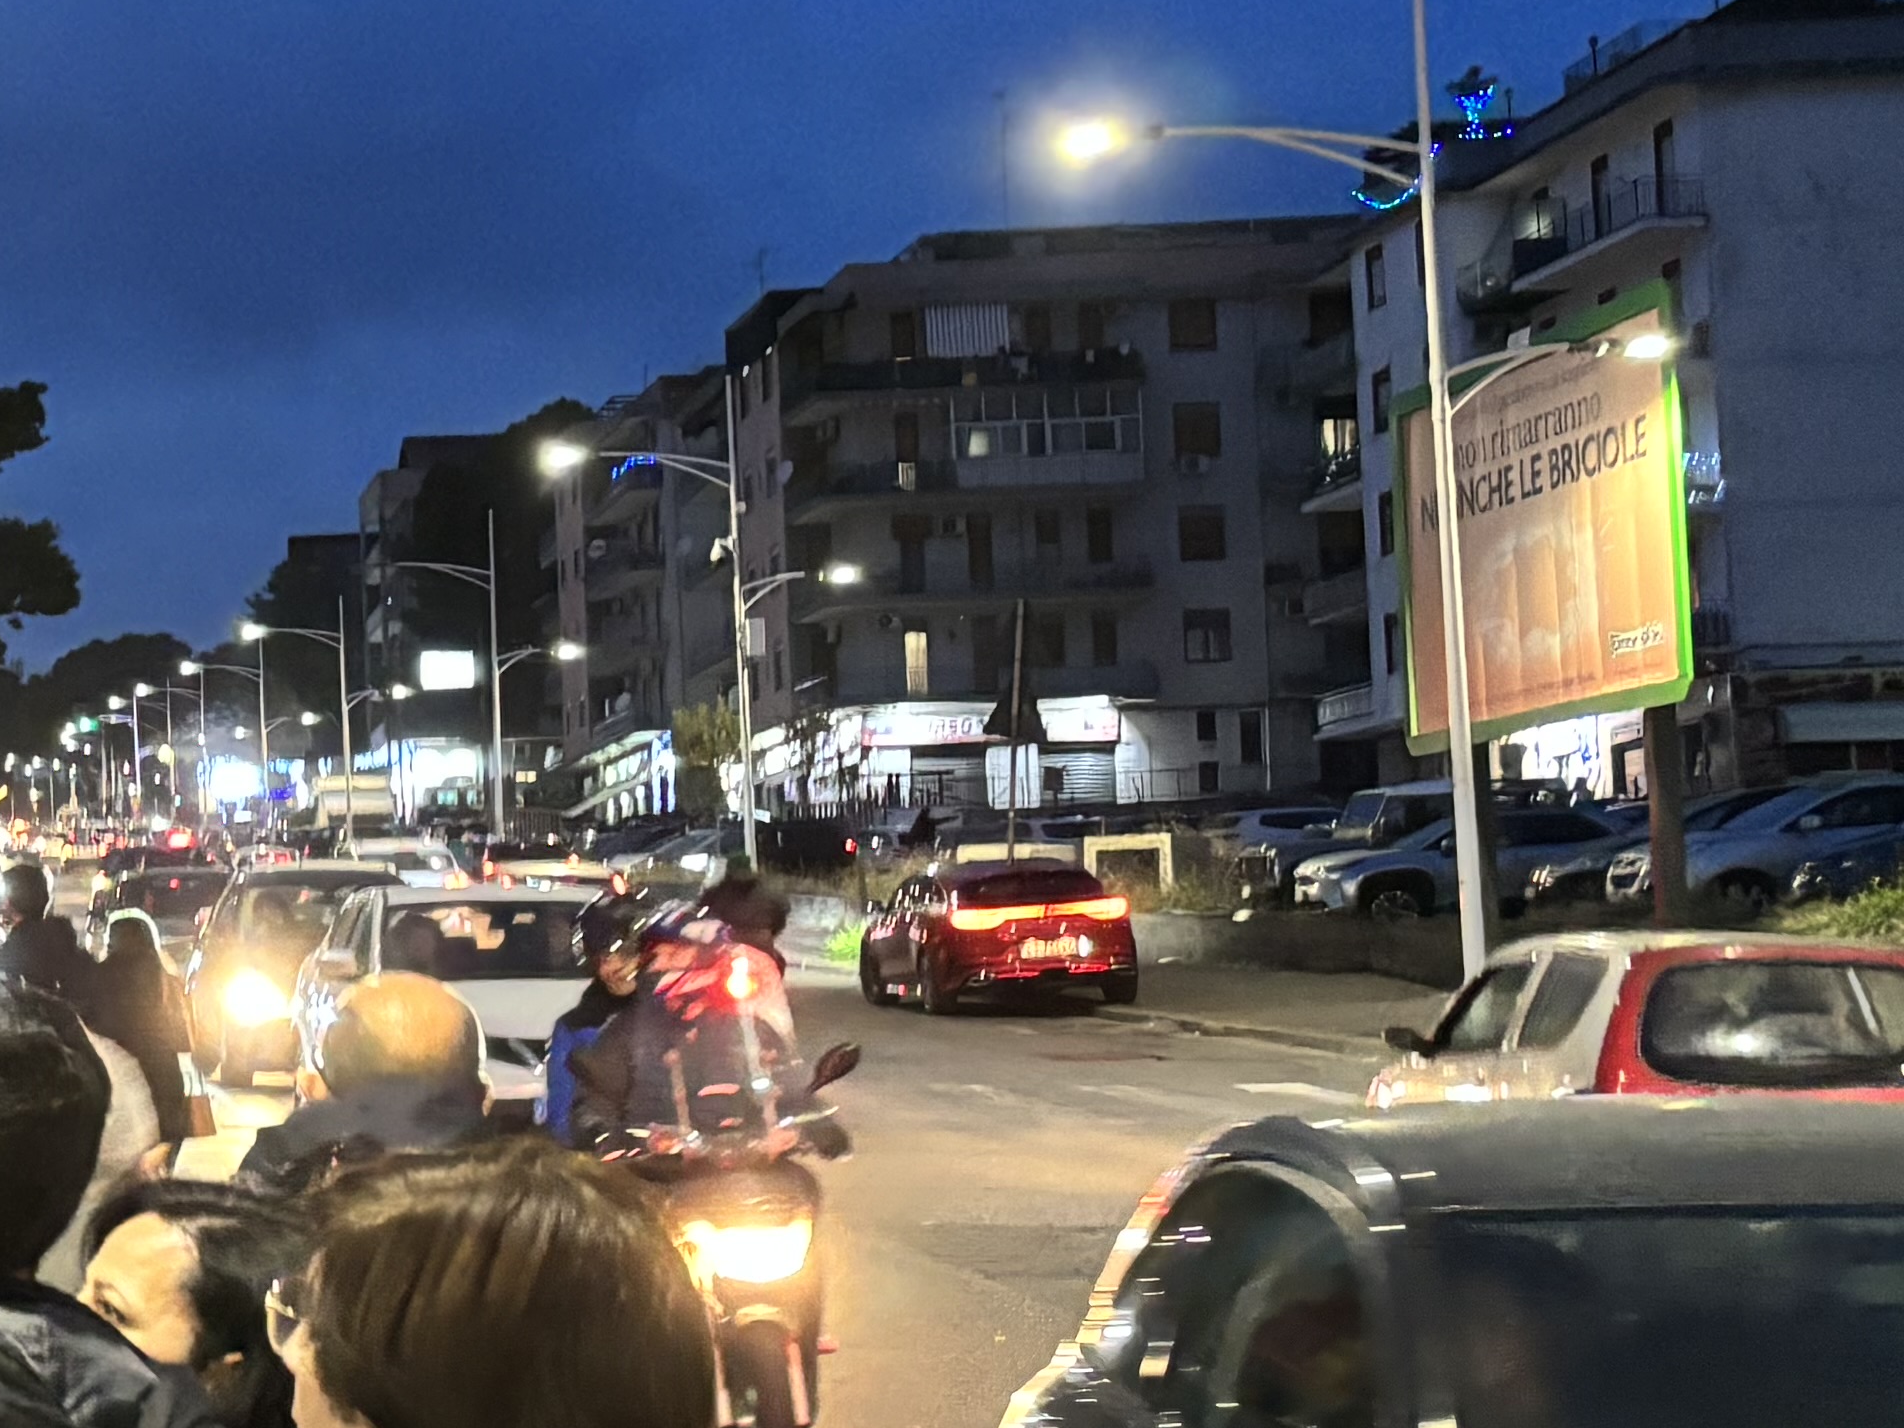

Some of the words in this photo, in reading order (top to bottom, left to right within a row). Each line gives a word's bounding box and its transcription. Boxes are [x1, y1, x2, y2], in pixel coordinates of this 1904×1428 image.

[1420, 465, 1515, 532] NNCHE
[1519, 452, 1544, 500] LE
[1548, 414, 1647, 490] BRICIOLE
